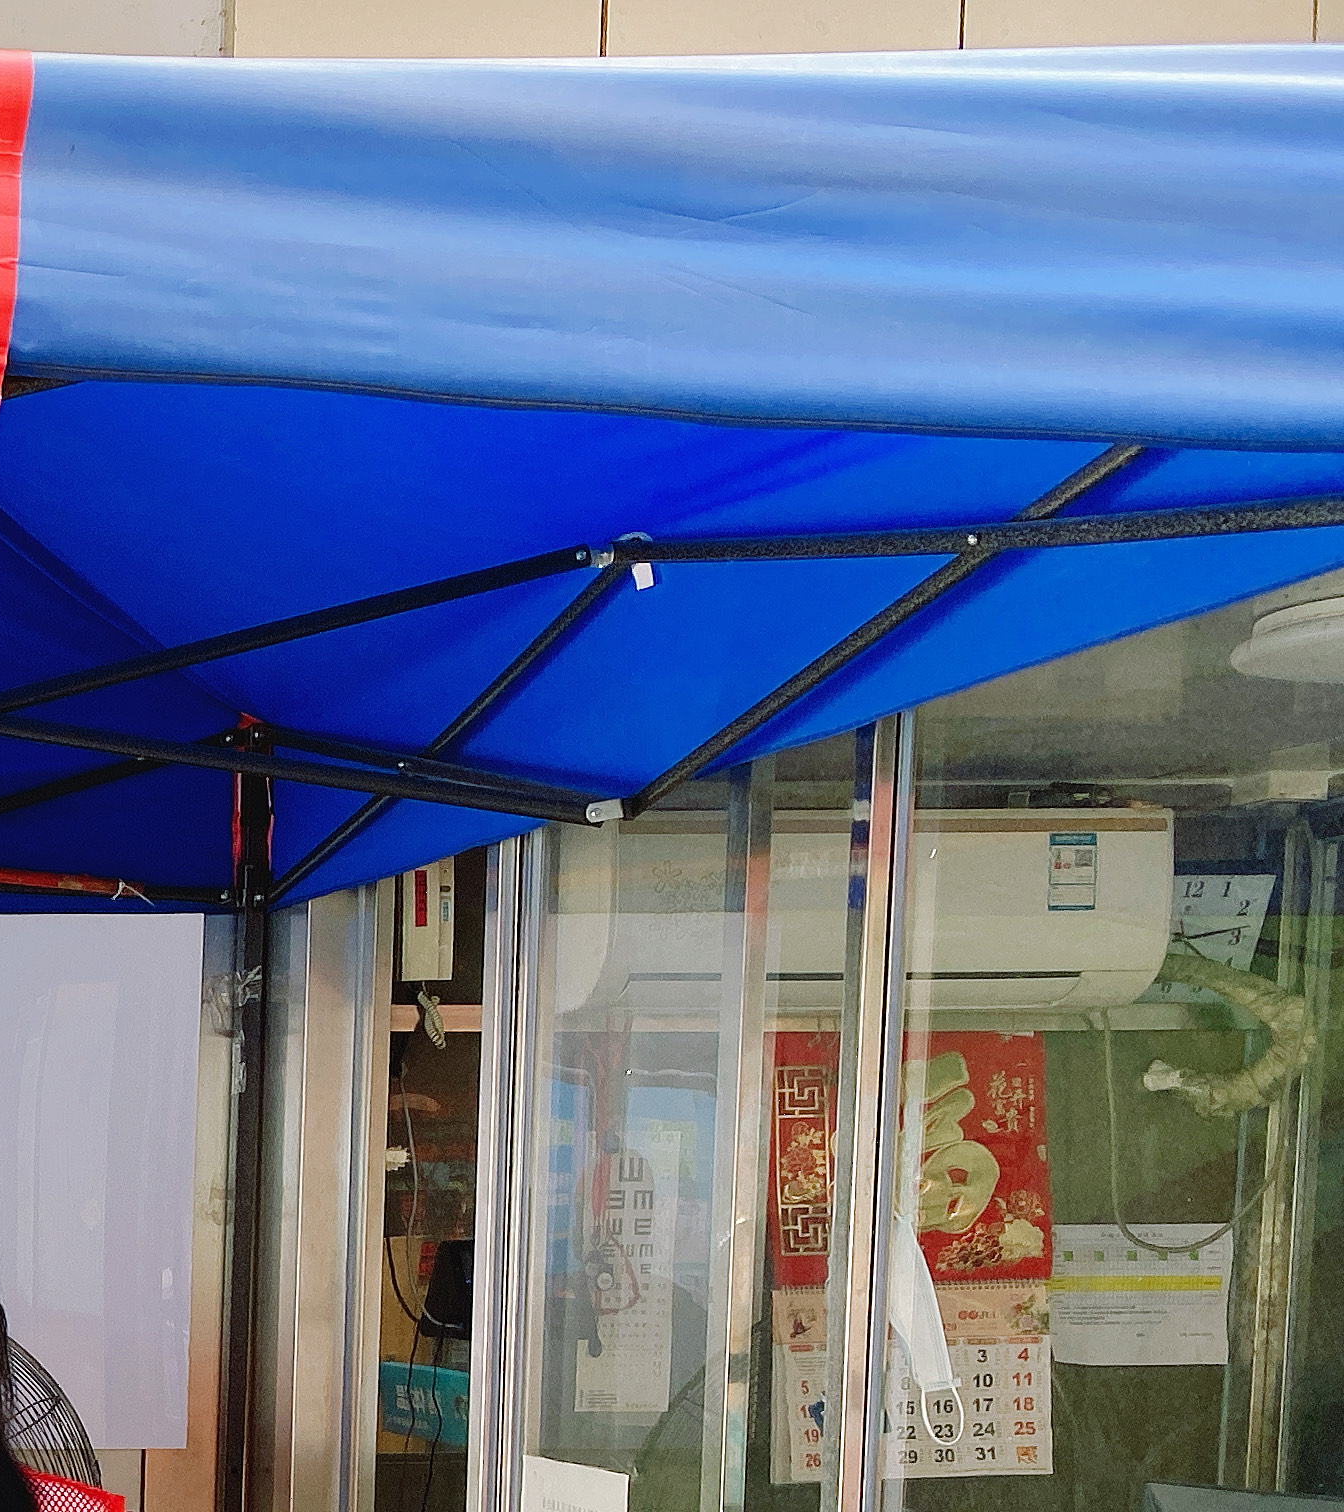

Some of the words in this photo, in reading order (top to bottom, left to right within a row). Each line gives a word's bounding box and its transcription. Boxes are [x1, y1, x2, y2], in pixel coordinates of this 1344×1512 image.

[1183, 881, 1204, 897] 12
[1221, 881, 1231, 897] 1
[1236, 899, 1250, 916] 2
[1228, 928, 1241, 945] 3
[977, 1349, 988, 1363] 3
[1018, 1348, 1029, 1361] 4
[801, 1380, 809, 1395] 5
[972, 1373, 993, 1388] 10
[1012, 1372, 1032, 1386] 11
[896, 1400, 915, 1415] 15
[933, 1400, 953, 1414] 16
[972, 1398, 994, 1412] 17
[1013, 1397, 1034, 1411] 18
[804, 1429, 819, 1443] 19
[896, 1425, 916, 1440] 22
[933, 1424, 954, 1439] 23
[972, 1422, 995, 1437] 24
[1014, 1421, 1036, 1435] 25
[805, 1453, 821, 1468] 26
[898, 1450, 917, 1463] 29
[934, 1448, 955, 1463] 30
[975, 1446, 996, 1461] 31
